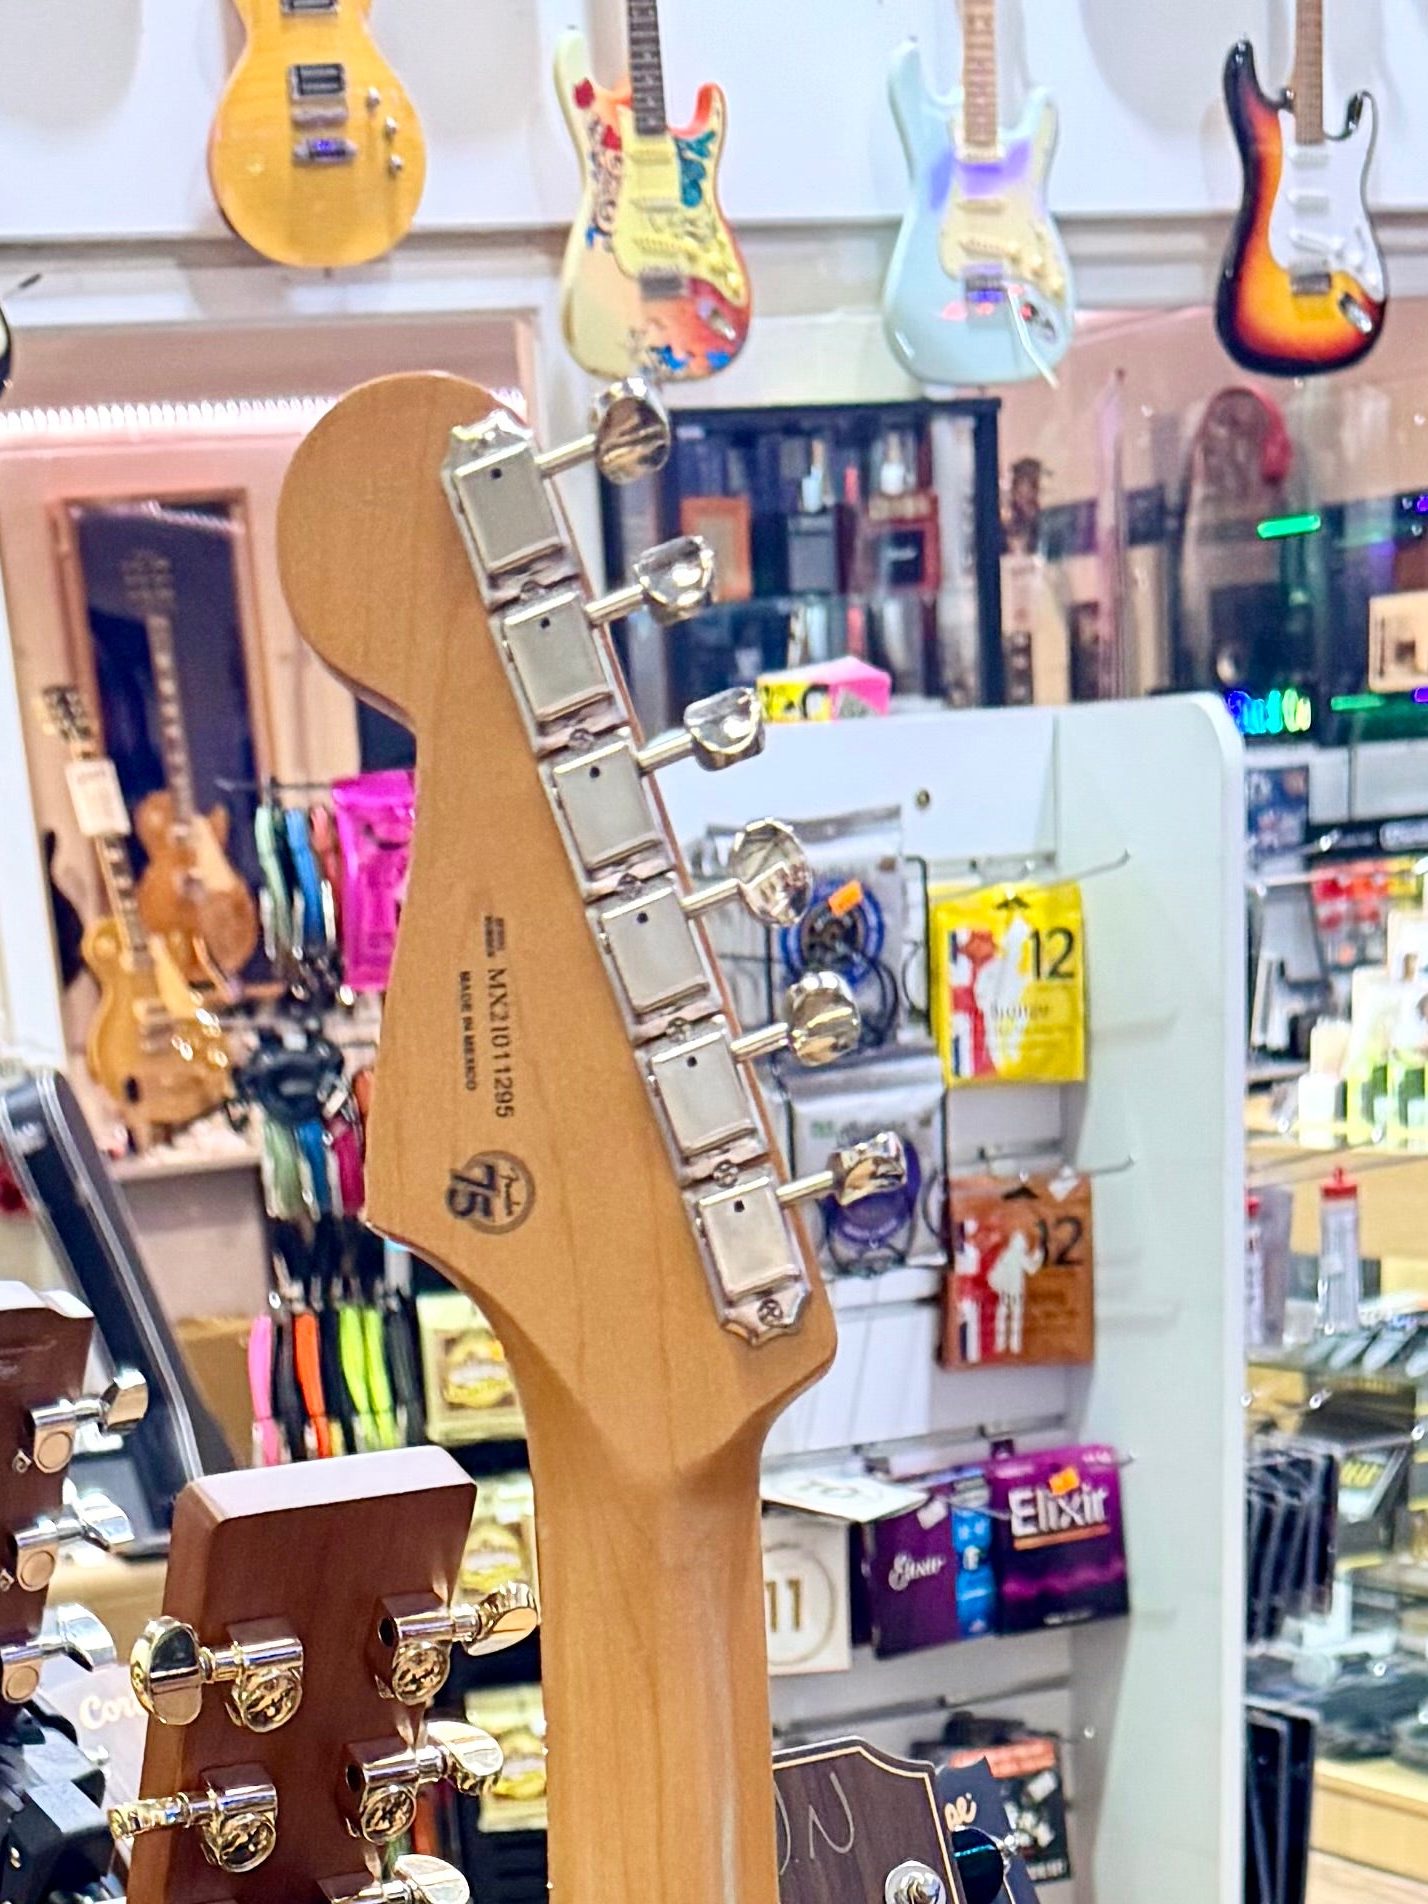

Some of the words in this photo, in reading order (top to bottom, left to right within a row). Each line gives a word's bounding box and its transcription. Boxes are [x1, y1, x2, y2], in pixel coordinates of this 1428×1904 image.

[1029, 926, 1076, 981] 12
[487, 967, 515, 1119] MX21011295
[445, 1163, 498, 1220] 75
[1008, 1483, 1109, 1538] Elixir
[80, 1695, 150, 1730] Cor
